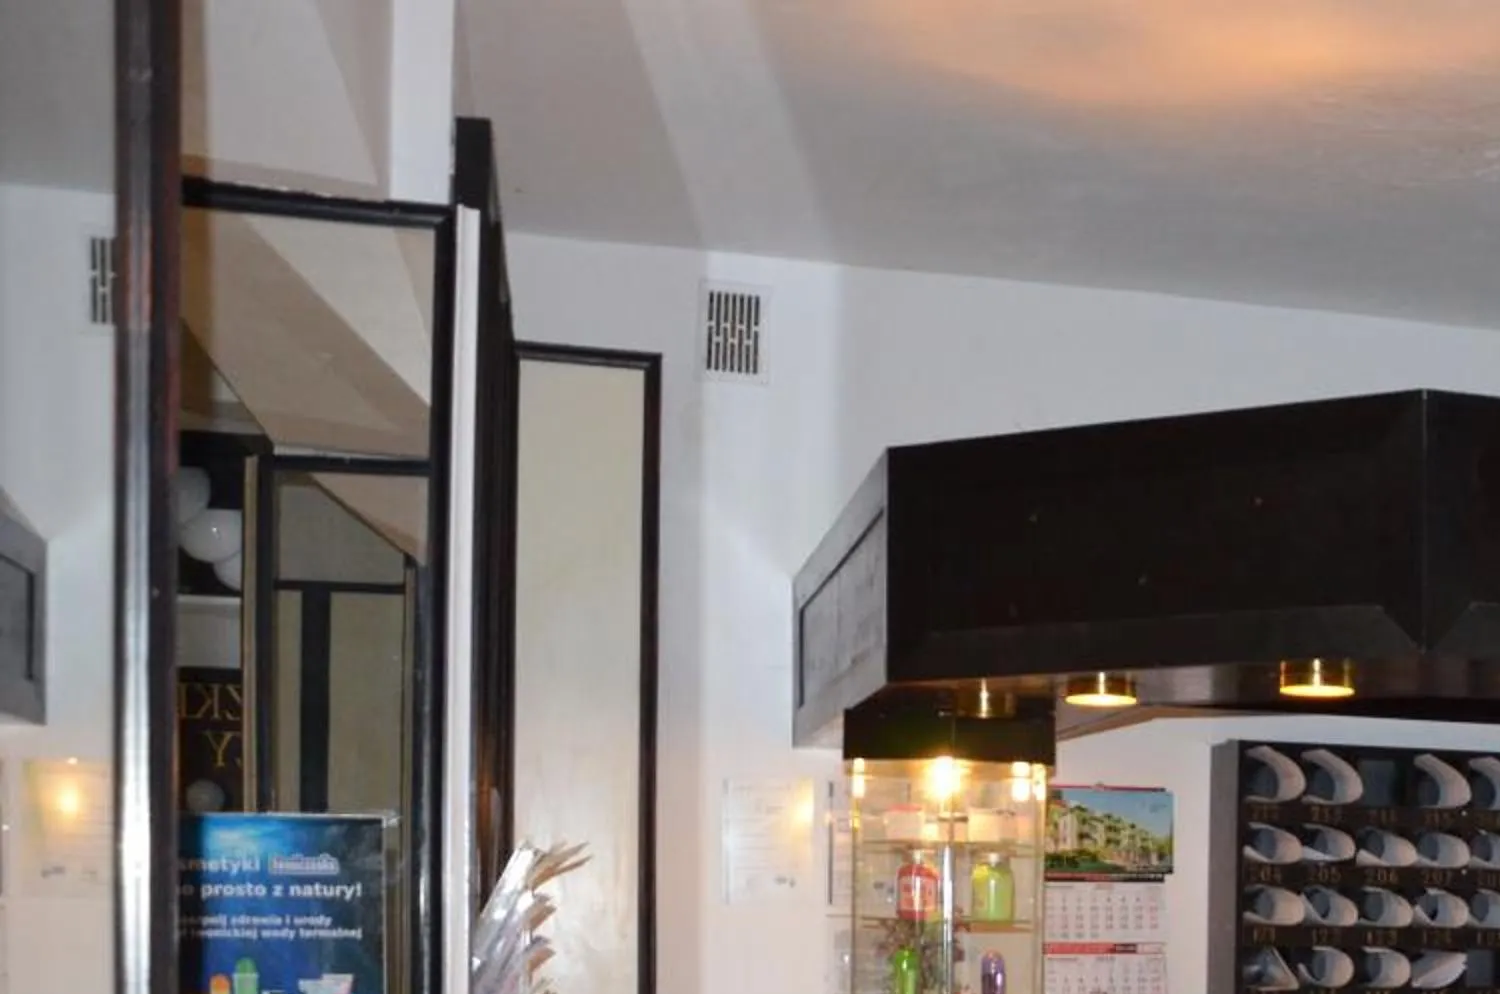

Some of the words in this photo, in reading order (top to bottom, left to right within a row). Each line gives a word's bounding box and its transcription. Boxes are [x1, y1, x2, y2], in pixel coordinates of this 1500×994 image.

[201, 883, 268, 900] prosto
[271, 884, 284, 897] z
[289, 882, 363, 900] natury!
